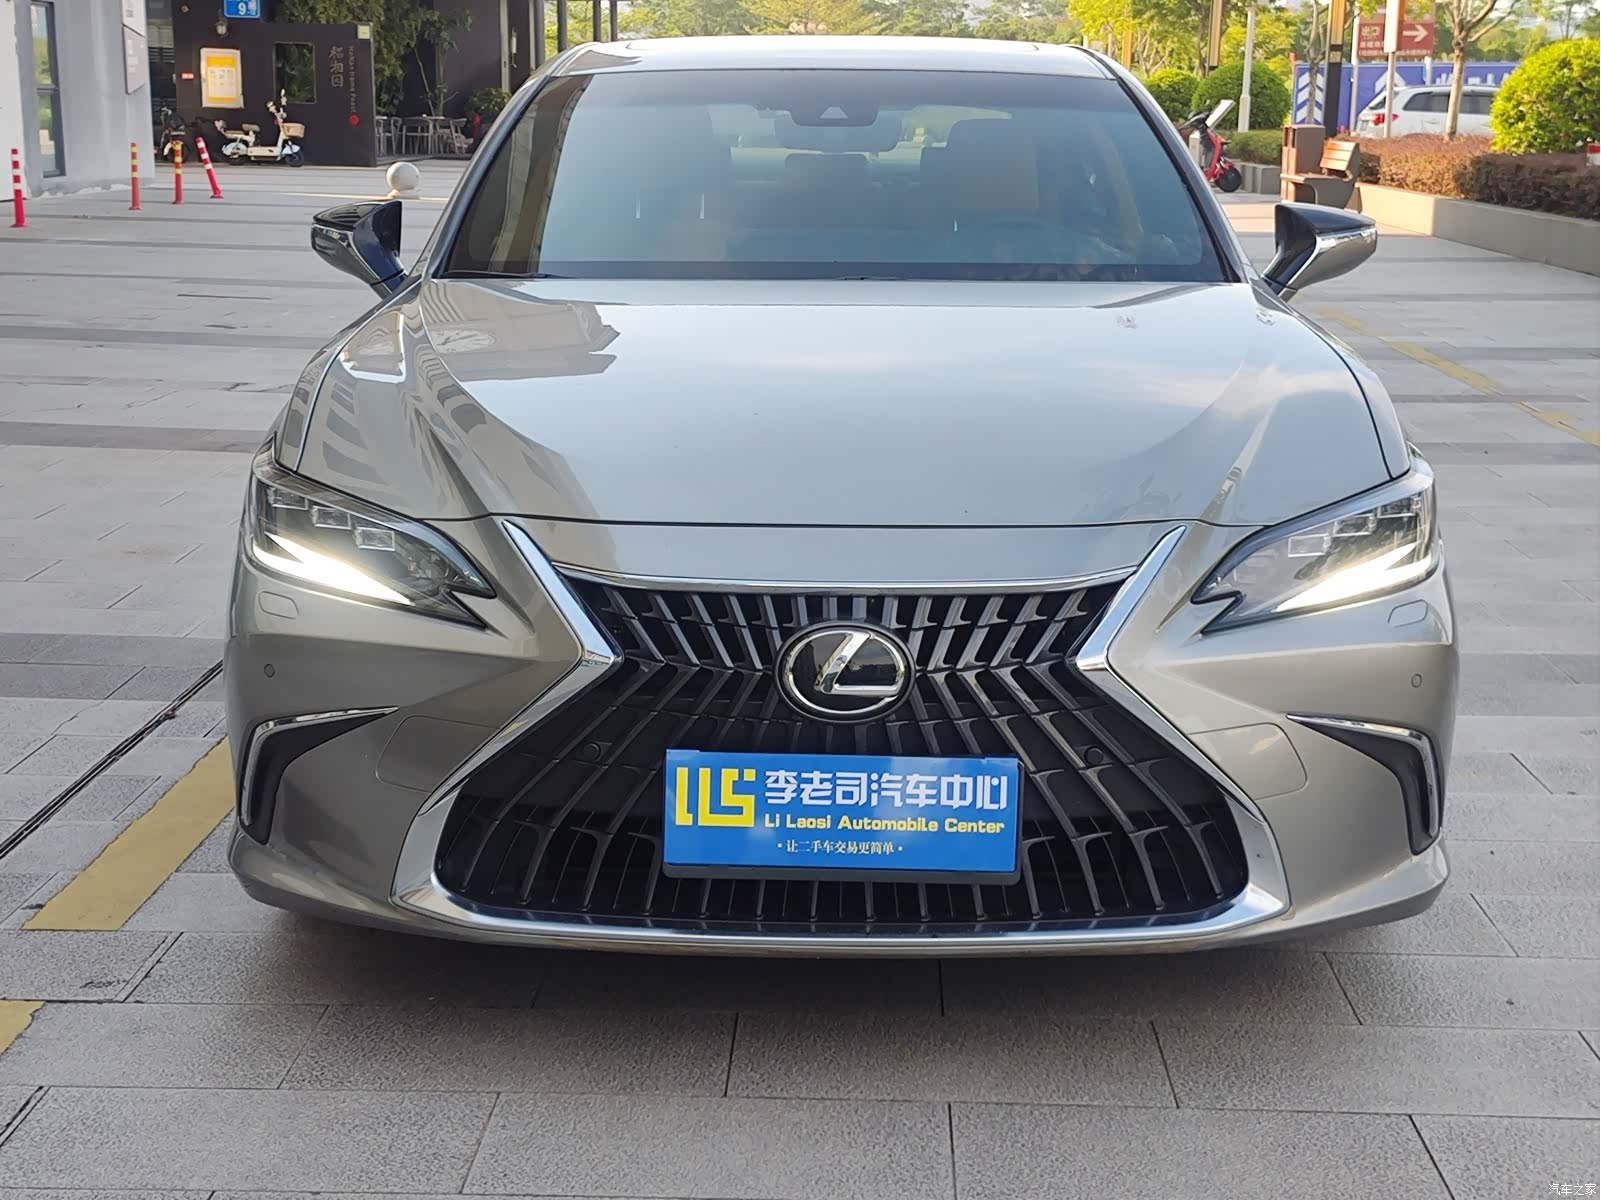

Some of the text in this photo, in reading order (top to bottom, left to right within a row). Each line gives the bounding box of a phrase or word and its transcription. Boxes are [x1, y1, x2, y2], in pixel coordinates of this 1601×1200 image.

[764, 769, 1008, 811] 李老司汽车中心
[764, 813, 1006, 835] Li Laosi Automobile Center
